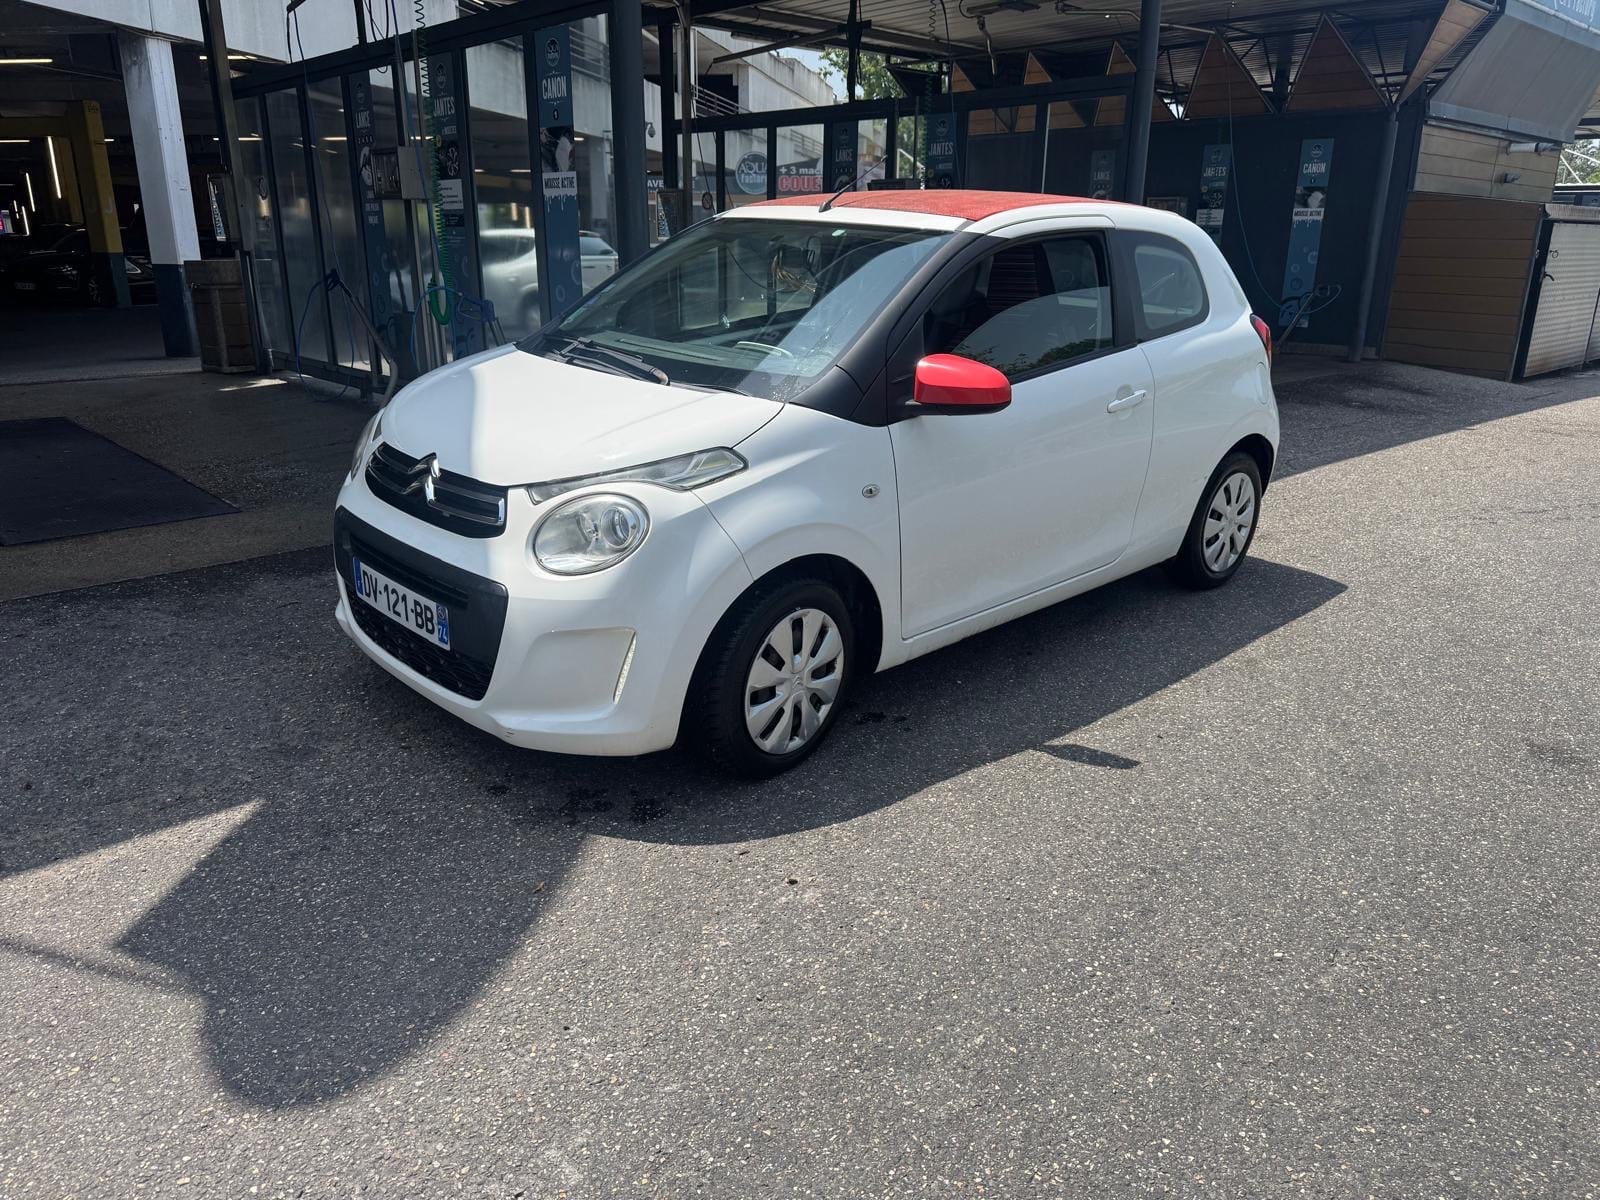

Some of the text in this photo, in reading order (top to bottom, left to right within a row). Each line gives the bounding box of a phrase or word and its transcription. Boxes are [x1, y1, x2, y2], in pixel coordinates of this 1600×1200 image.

[542, 76, 567, 99] CANON
[433, 96, 455, 117] JANTES
[835, 148, 853, 162] LANCE
[929, 142, 953, 156] JANTES
[790, 166, 797, 174] 3
[1303, 162, 1326, 174] CANON
[362, 569, 435, 635] DV-121-BB
[438, 625, 448, 643] 74
